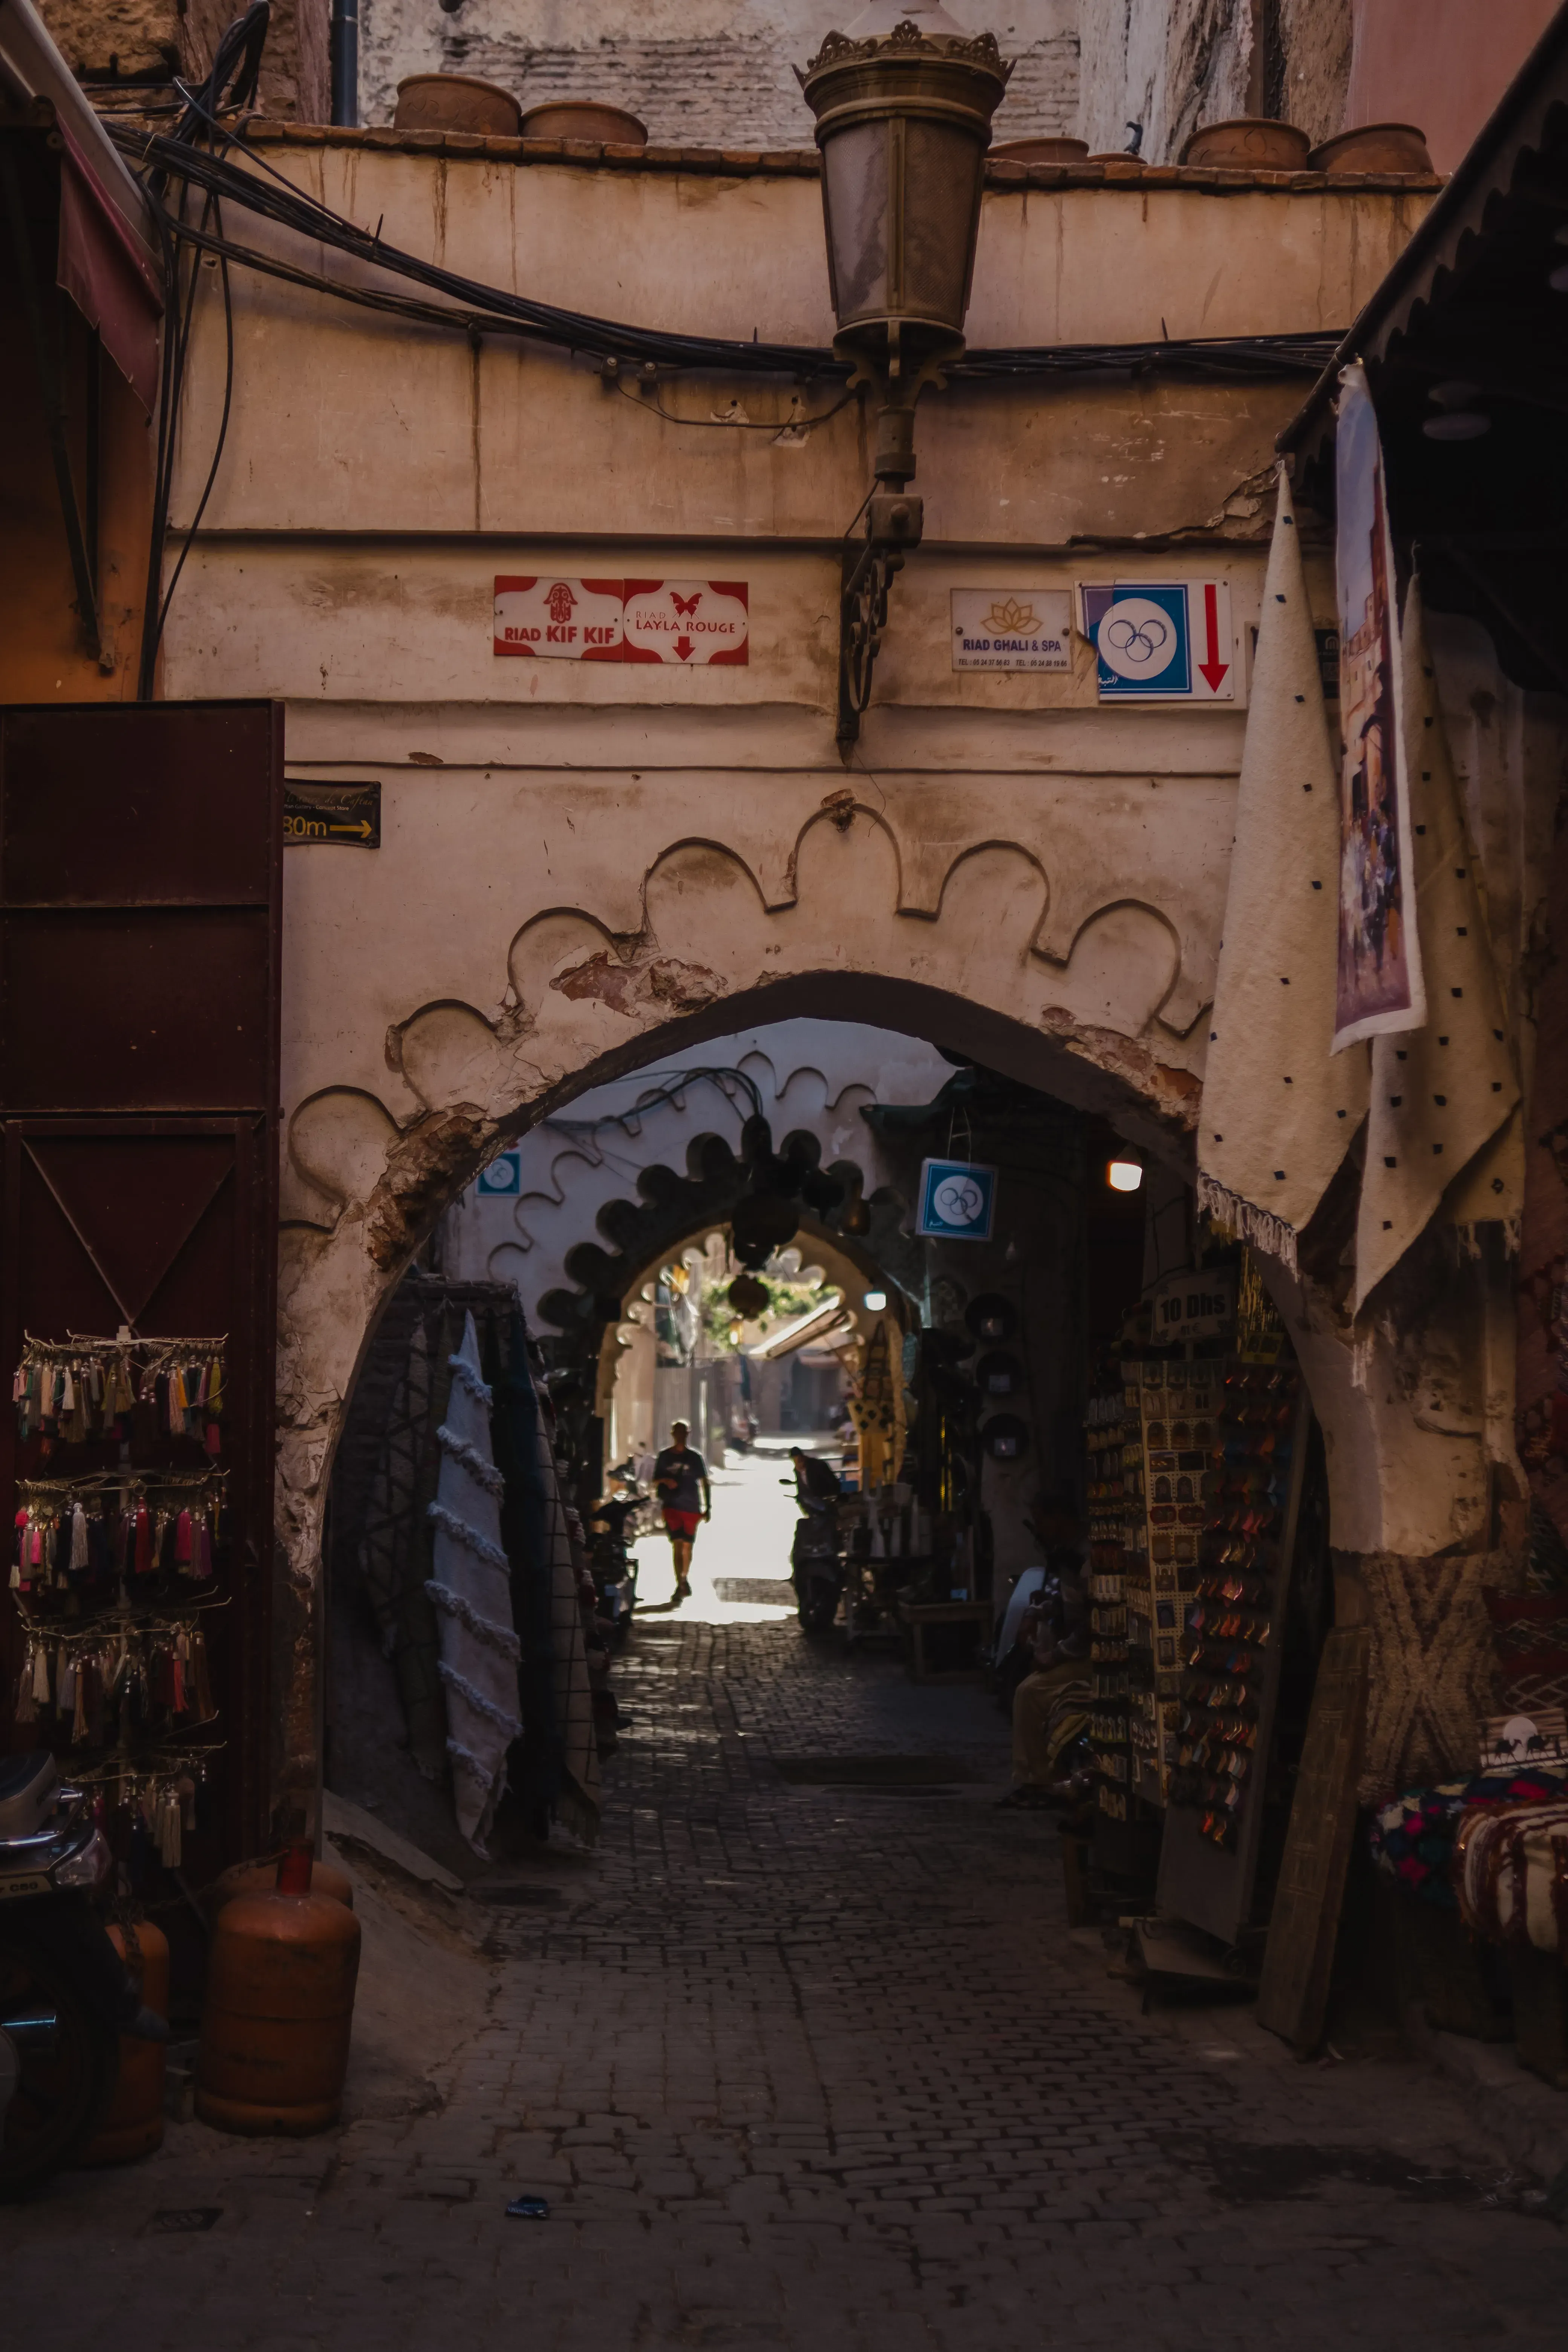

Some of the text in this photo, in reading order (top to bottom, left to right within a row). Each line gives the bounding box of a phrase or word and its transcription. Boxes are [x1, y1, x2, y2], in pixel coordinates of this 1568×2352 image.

[636, 611, 666, 619] RIAD
[635, 619, 735, 633] LAYLA ROUGE
[504, 626, 615, 644] RIAD KIF KIF
[963, 639, 1061, 652] RIAD GHALI & SPA
[1160, 1292, 1226, 1324] 10 Dhs
